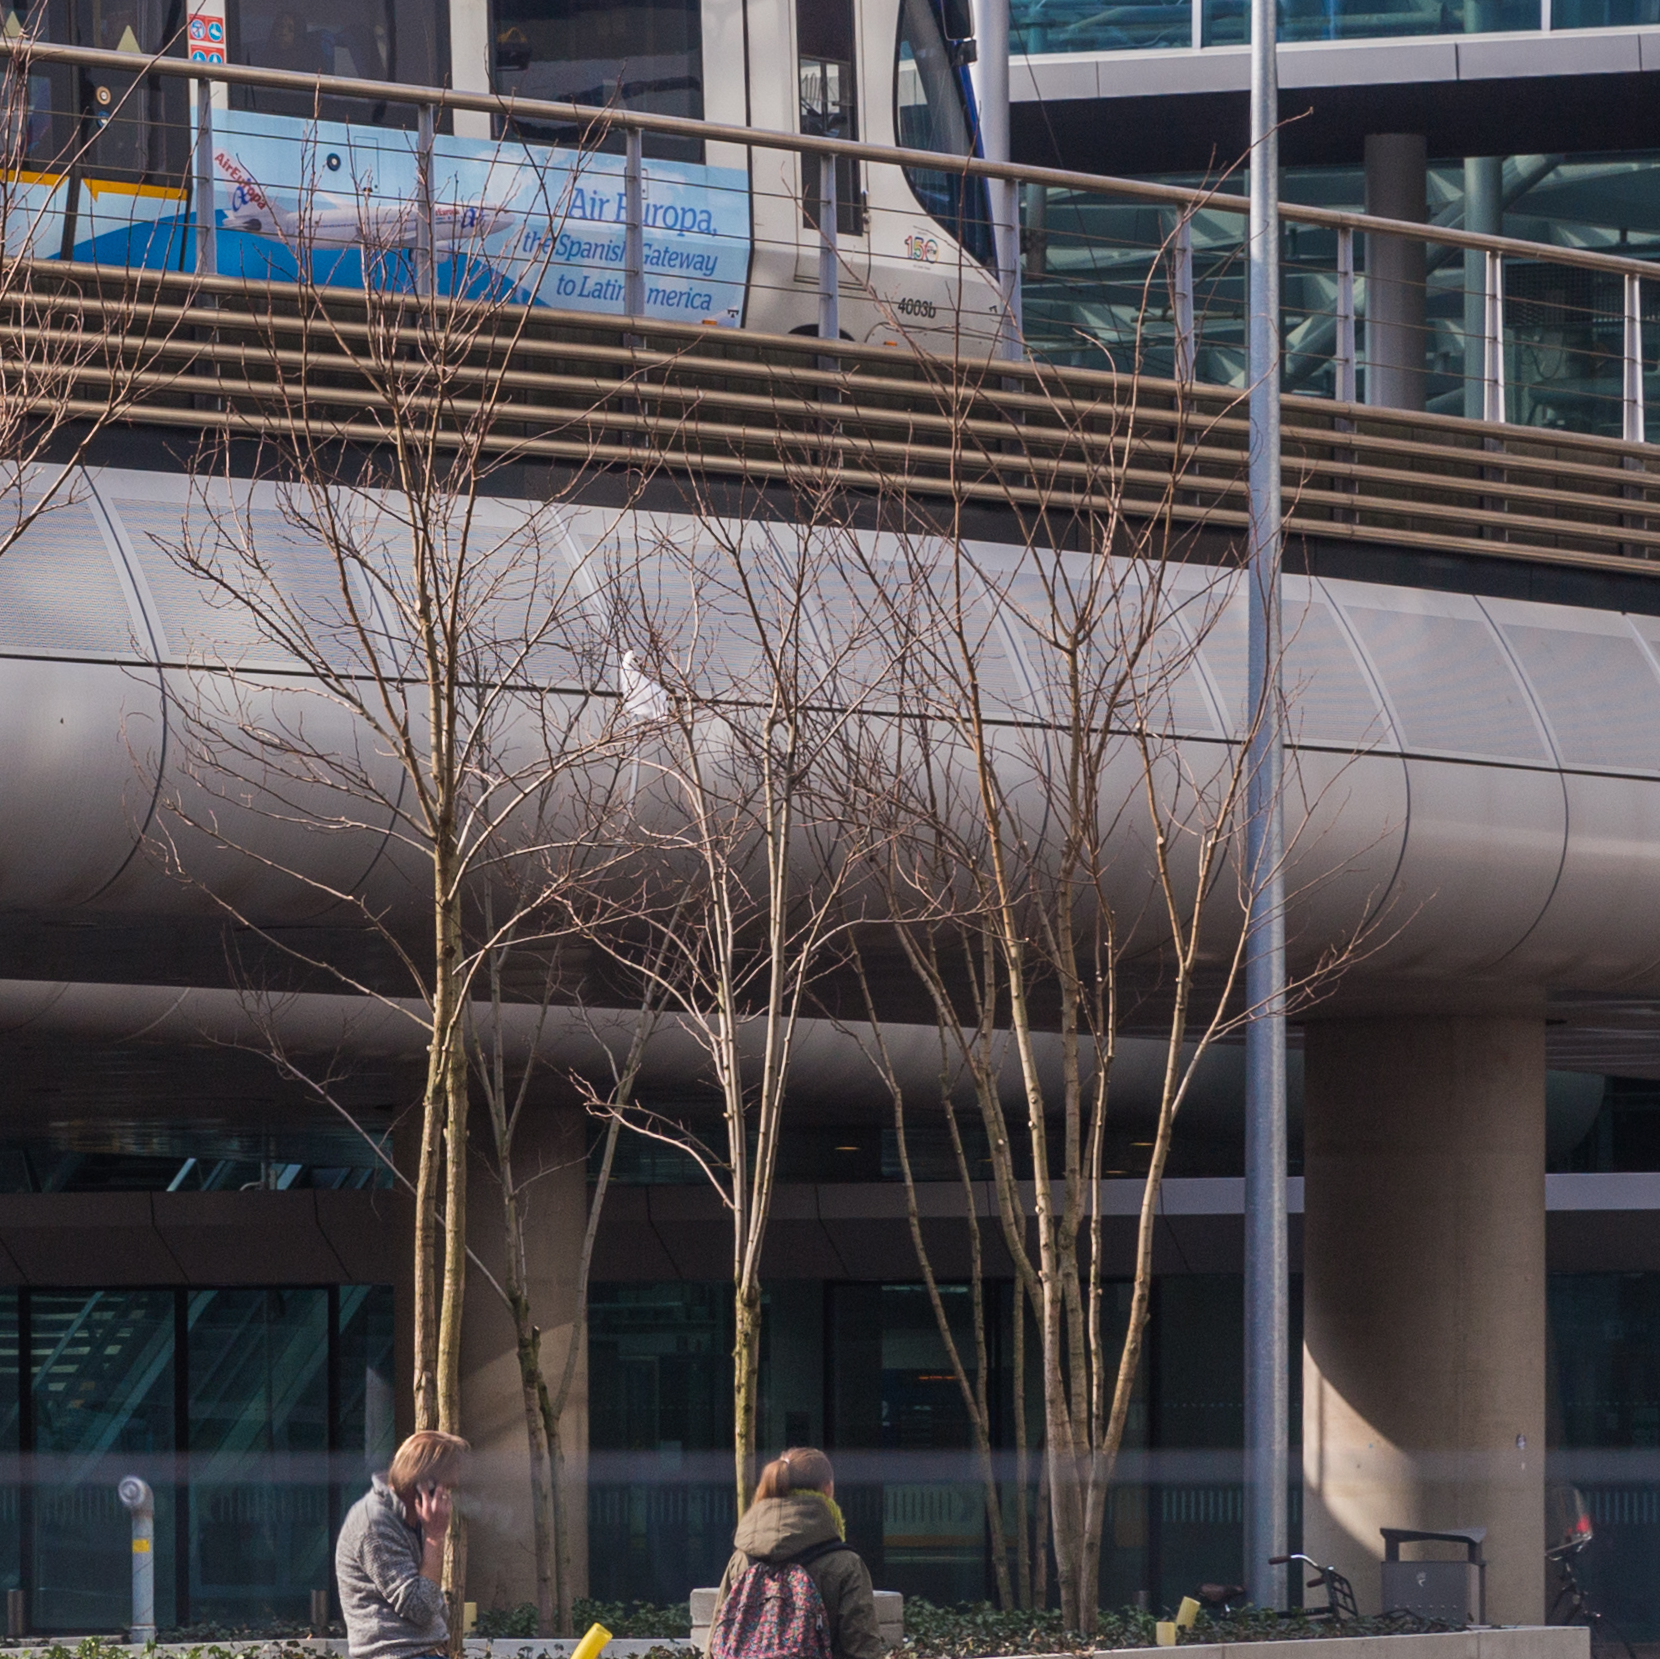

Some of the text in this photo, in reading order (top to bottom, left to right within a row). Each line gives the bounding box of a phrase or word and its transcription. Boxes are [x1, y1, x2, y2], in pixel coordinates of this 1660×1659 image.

[215, 152, 266, 210] AirEuropa
[568, 188, 610, 221] Air
[522, 231, 552, 255] the
[556, 274, 576, 296] to
[645, 287, 712, 311] merica
[898, 297, 936, 319] 4003b
